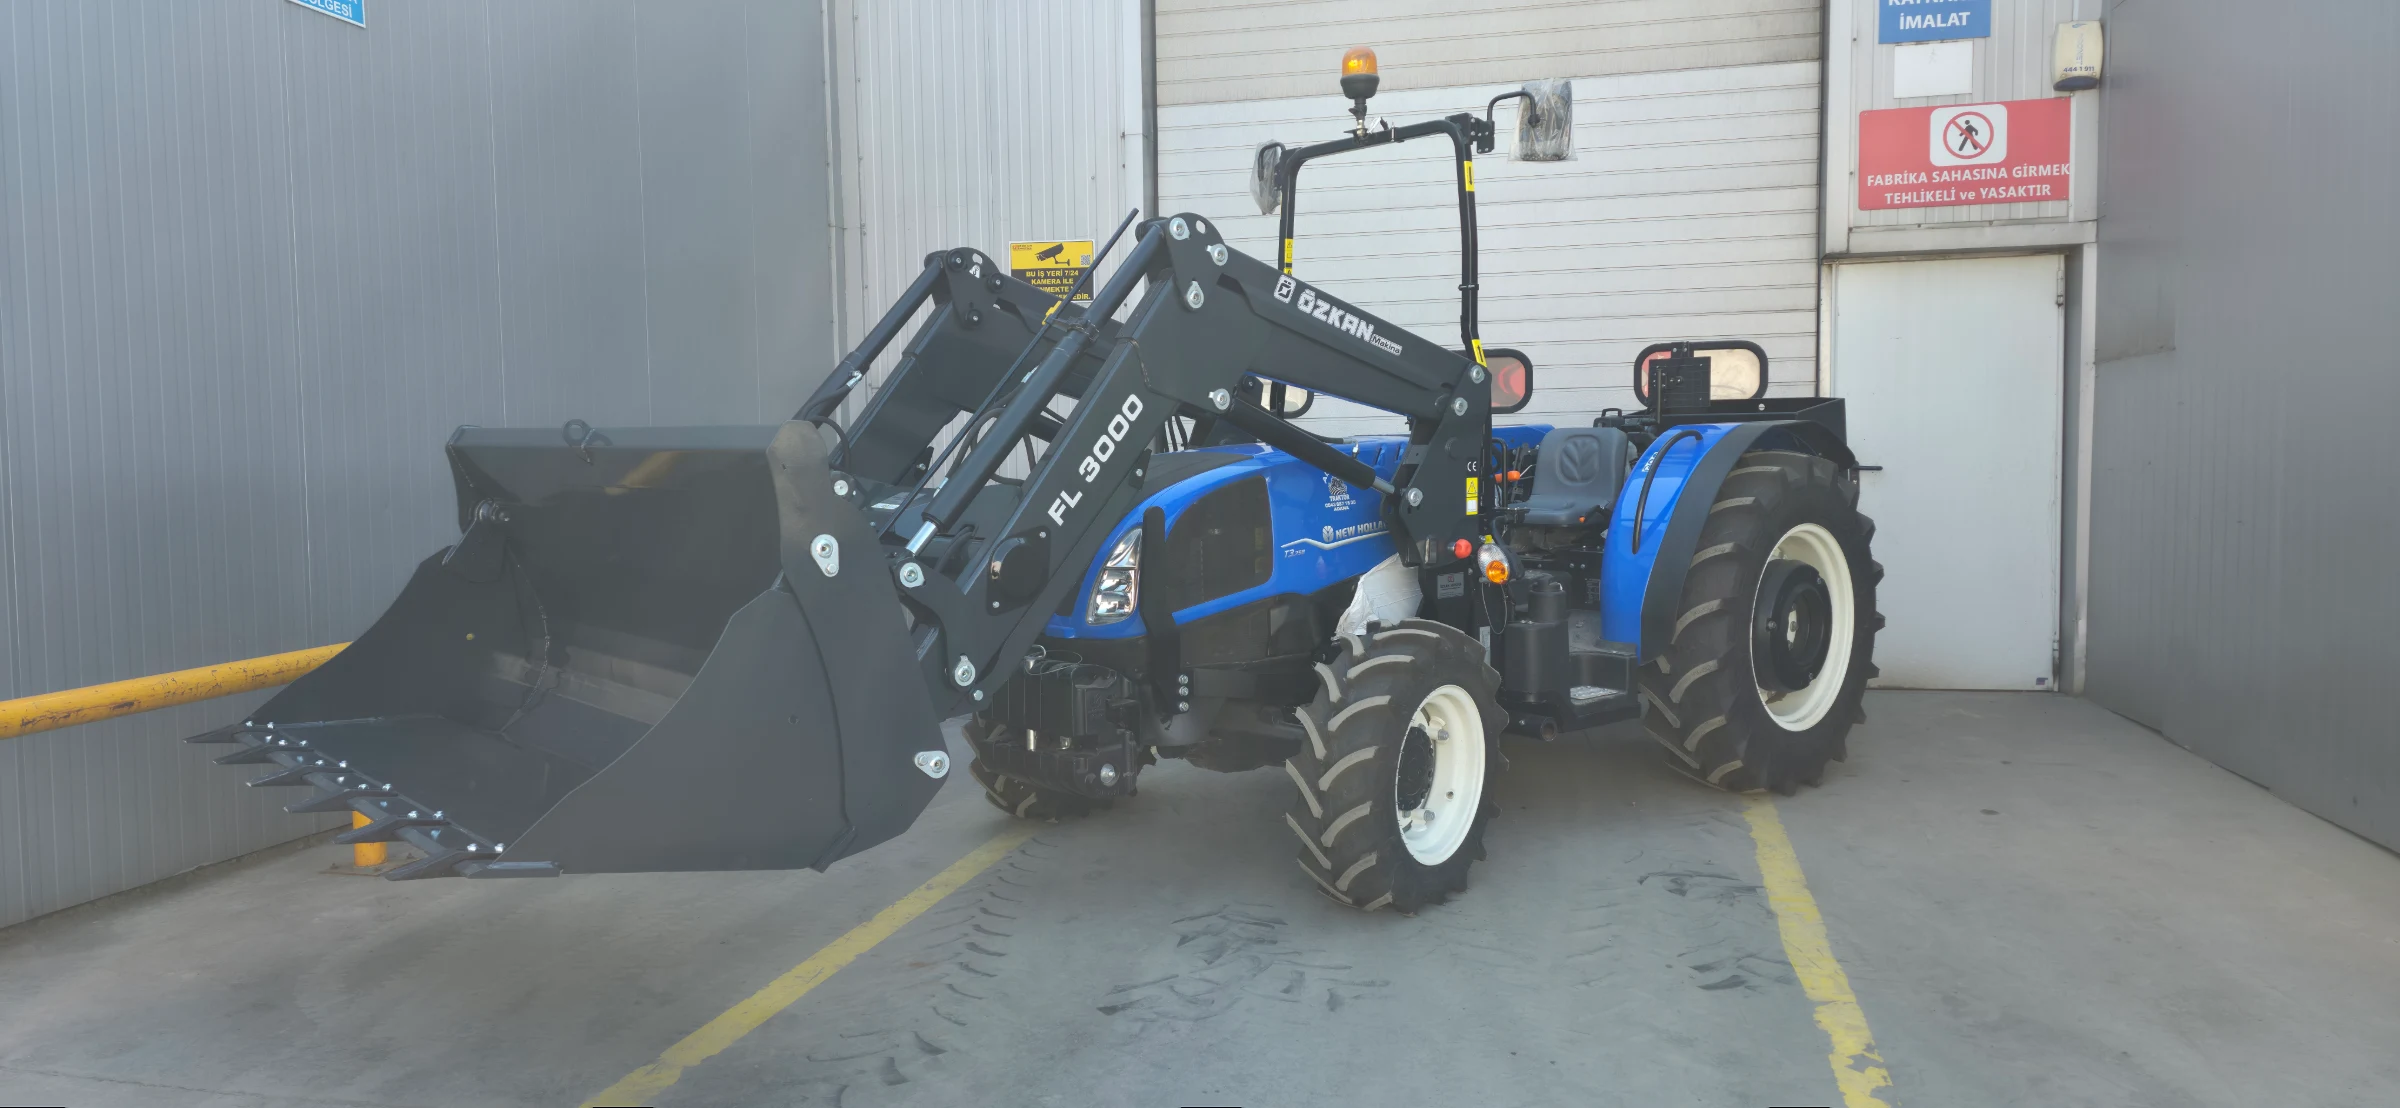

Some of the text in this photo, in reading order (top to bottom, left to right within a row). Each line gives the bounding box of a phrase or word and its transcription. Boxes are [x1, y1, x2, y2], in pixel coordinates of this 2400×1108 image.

[303, 0, 353, 18] LGESİ
[1899, 11, 1971, 30] İMALAT
[1867, 163, 2070, 187] FABRİKA SAHASINA GİRMEK
[1884, 184, 2051, 205] TEHLİKELİ ve YASAKTIR
[1037, 270, 1045, 278] İŞ
[1297, 288, 1401, 355] ÖZKAN Makina
[1047, 394, 1143, 526] FL 3000
[1335, 520, 1388, 540] NEW HOLLA
